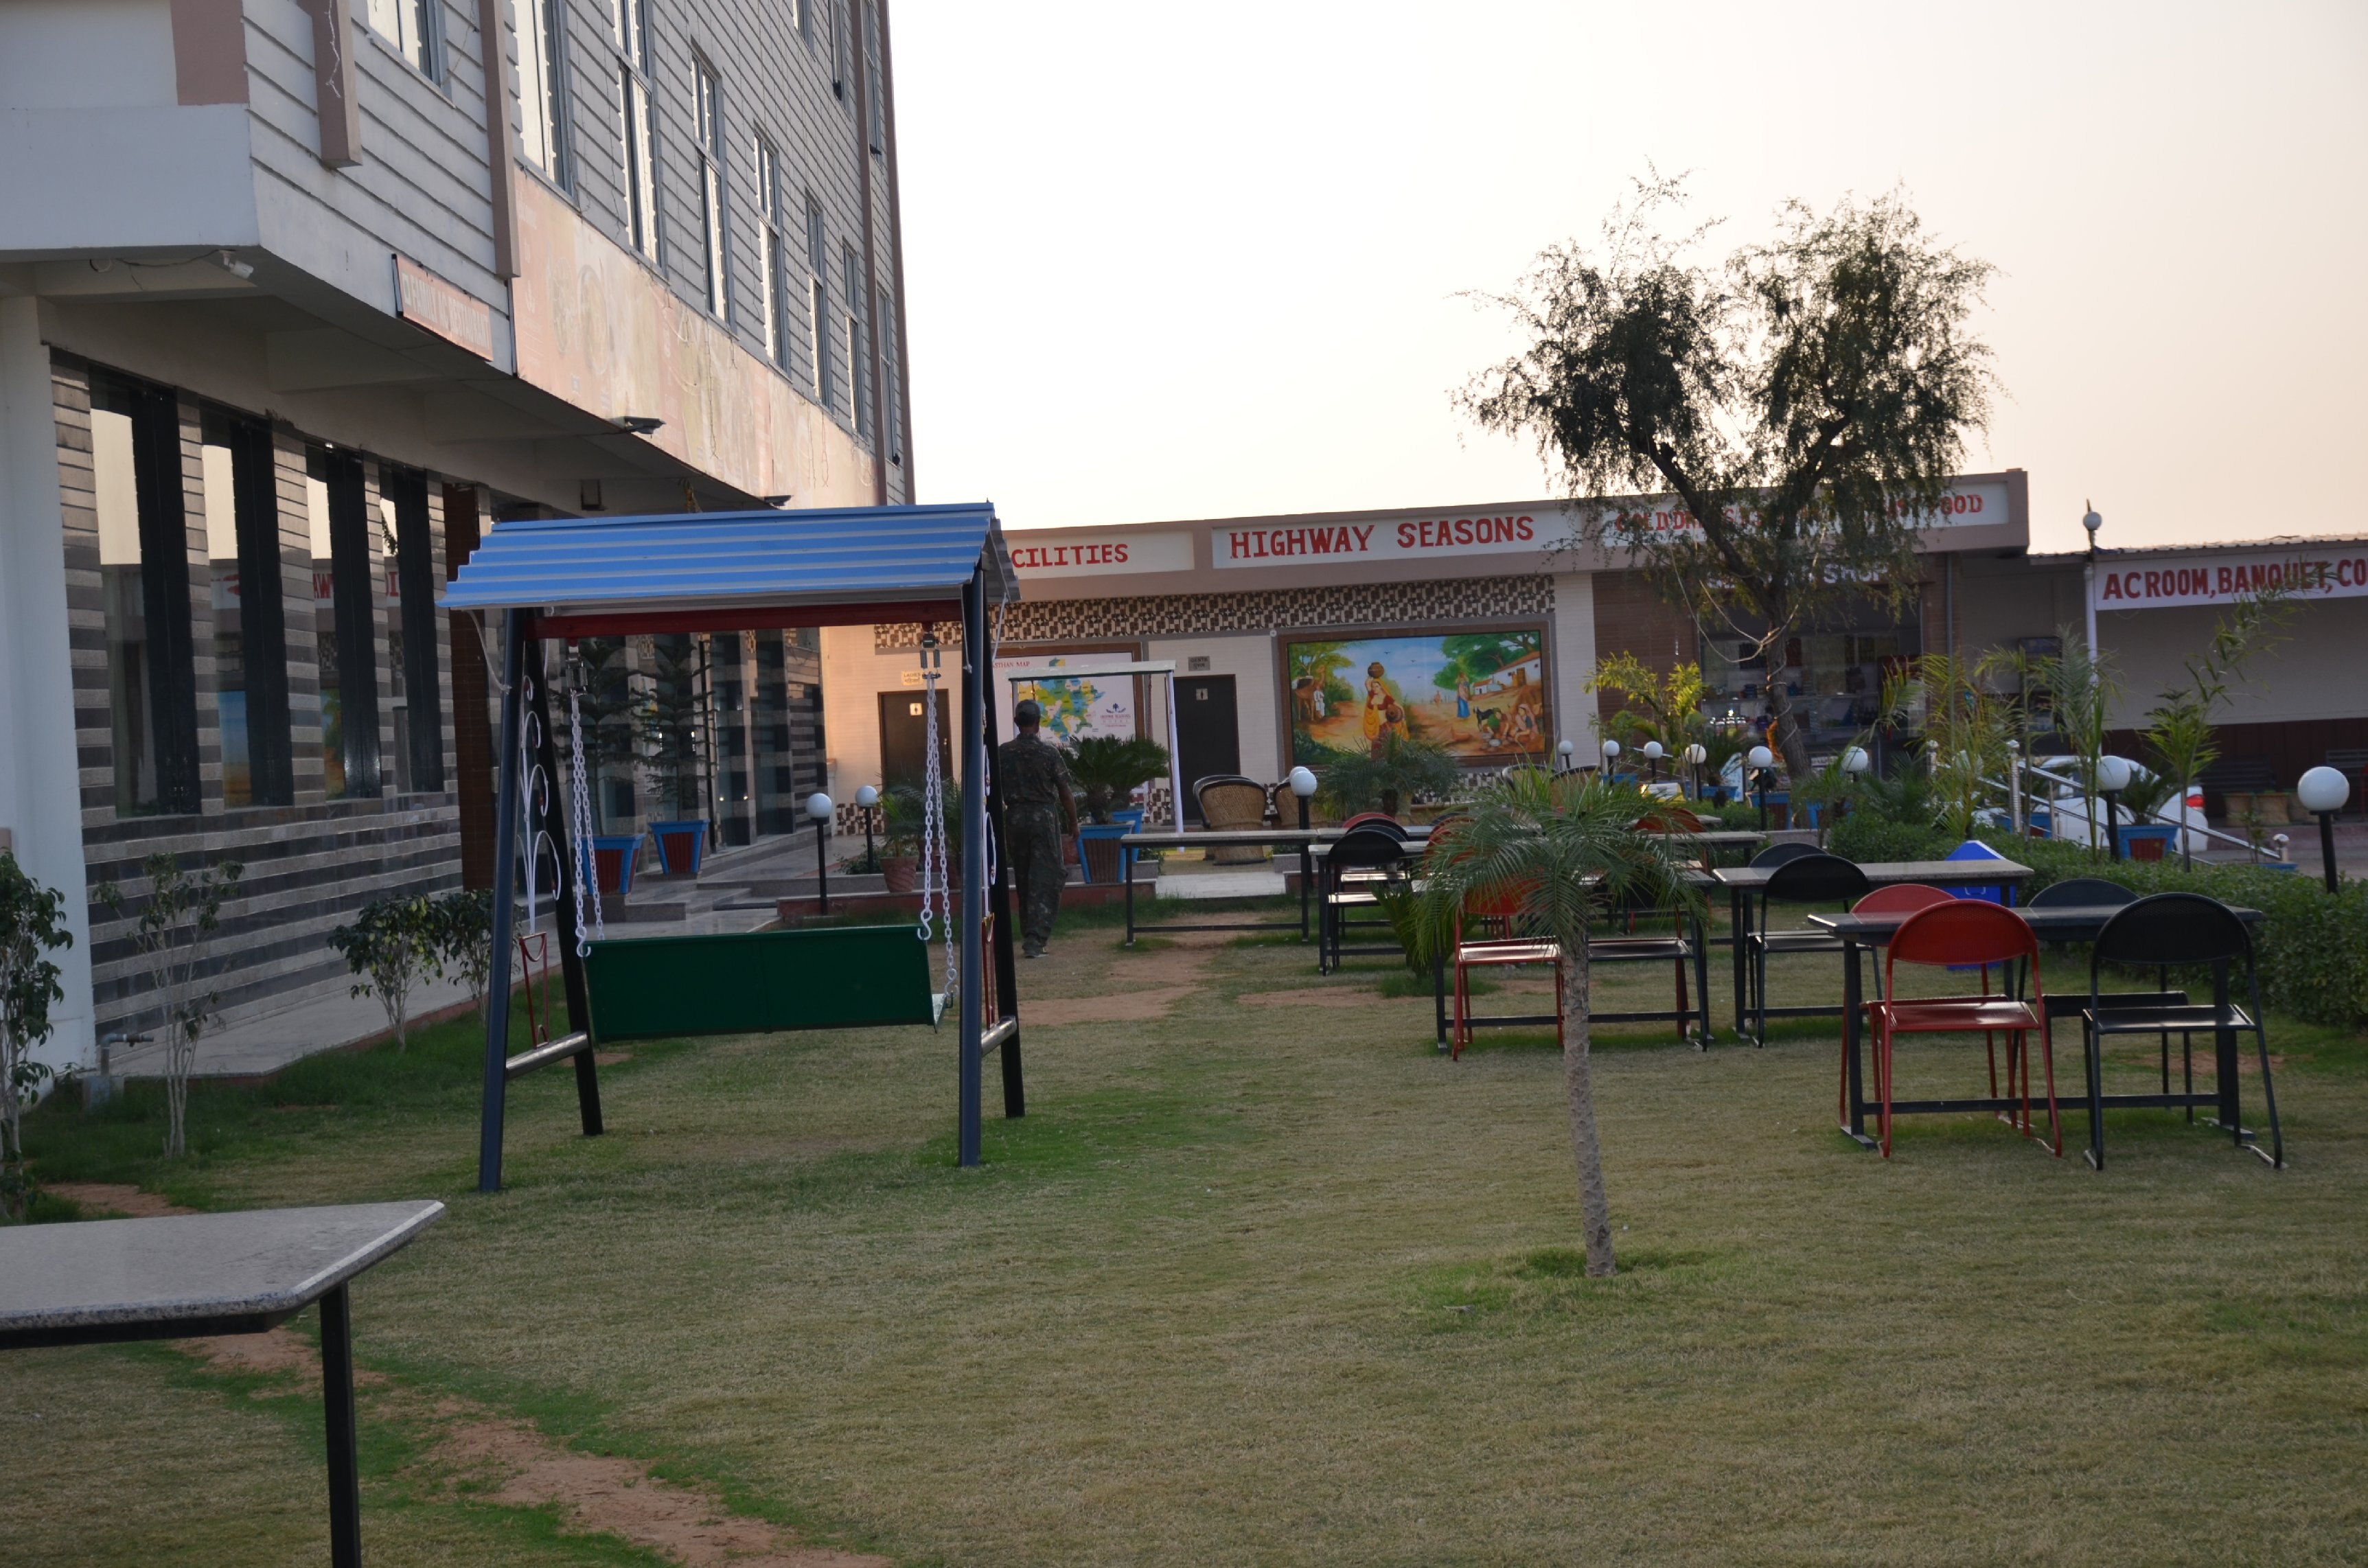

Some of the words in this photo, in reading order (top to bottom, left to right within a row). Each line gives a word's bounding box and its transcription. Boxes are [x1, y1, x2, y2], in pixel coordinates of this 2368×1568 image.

[411, 275, 437, 323] FAMILY
[449, 296, 490, 349] RESTAURANT
[1229, 524, 1375, 559] HIGHWAY
[1396, 516, 1534, 549] SEASONS
[1011, 544, 1129, 568] CILITIES
[2337, 558, 2368, 587] CO
